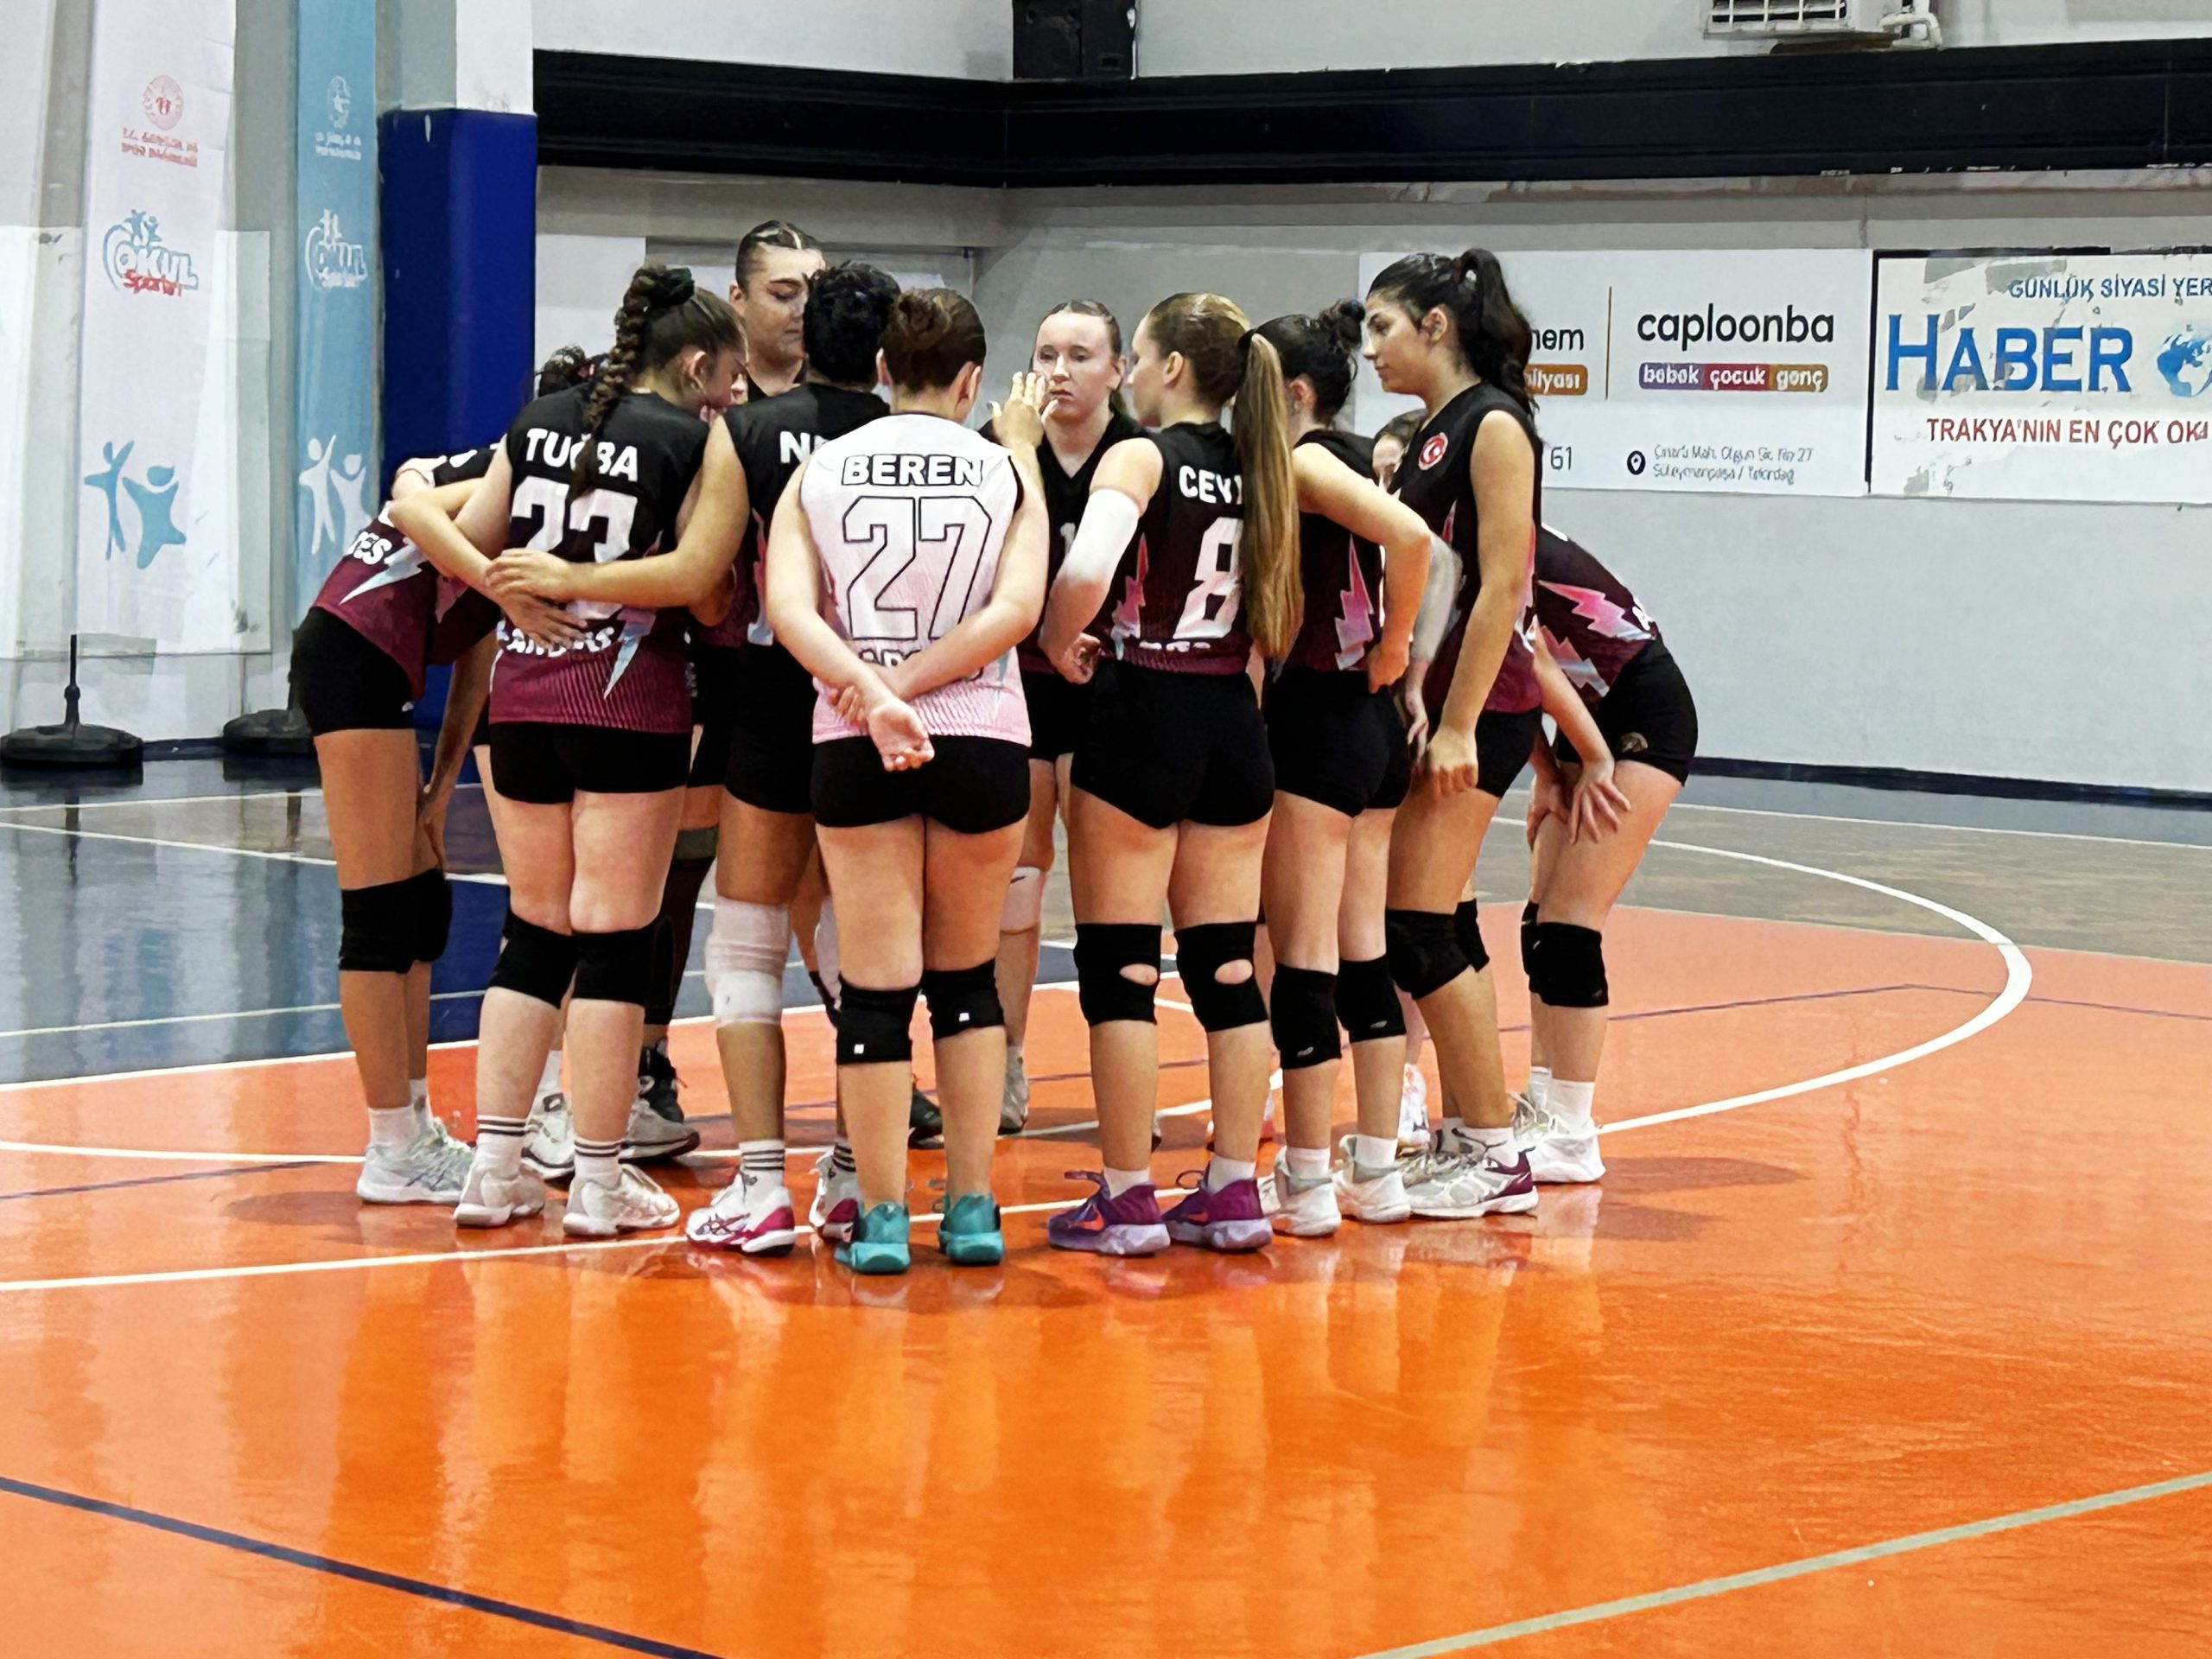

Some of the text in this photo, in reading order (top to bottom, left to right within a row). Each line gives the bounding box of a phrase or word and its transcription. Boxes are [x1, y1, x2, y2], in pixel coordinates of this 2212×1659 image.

[1637, 302, 1834, 352] caploonba
[1885, 313, 2132, 392] HABER
[1710, 366, 1765, 390] çocuk
[1926, 417, 2062, 443] TRAKYA'NIN
[2069, 419, 2101, 443] EN
[2107, 419, 2160, 449] ÇOK
[842, 454, 983, 487] BEREN
[1550, 446, 1572, 470] 61
[842, 495, 993, 641] 27
